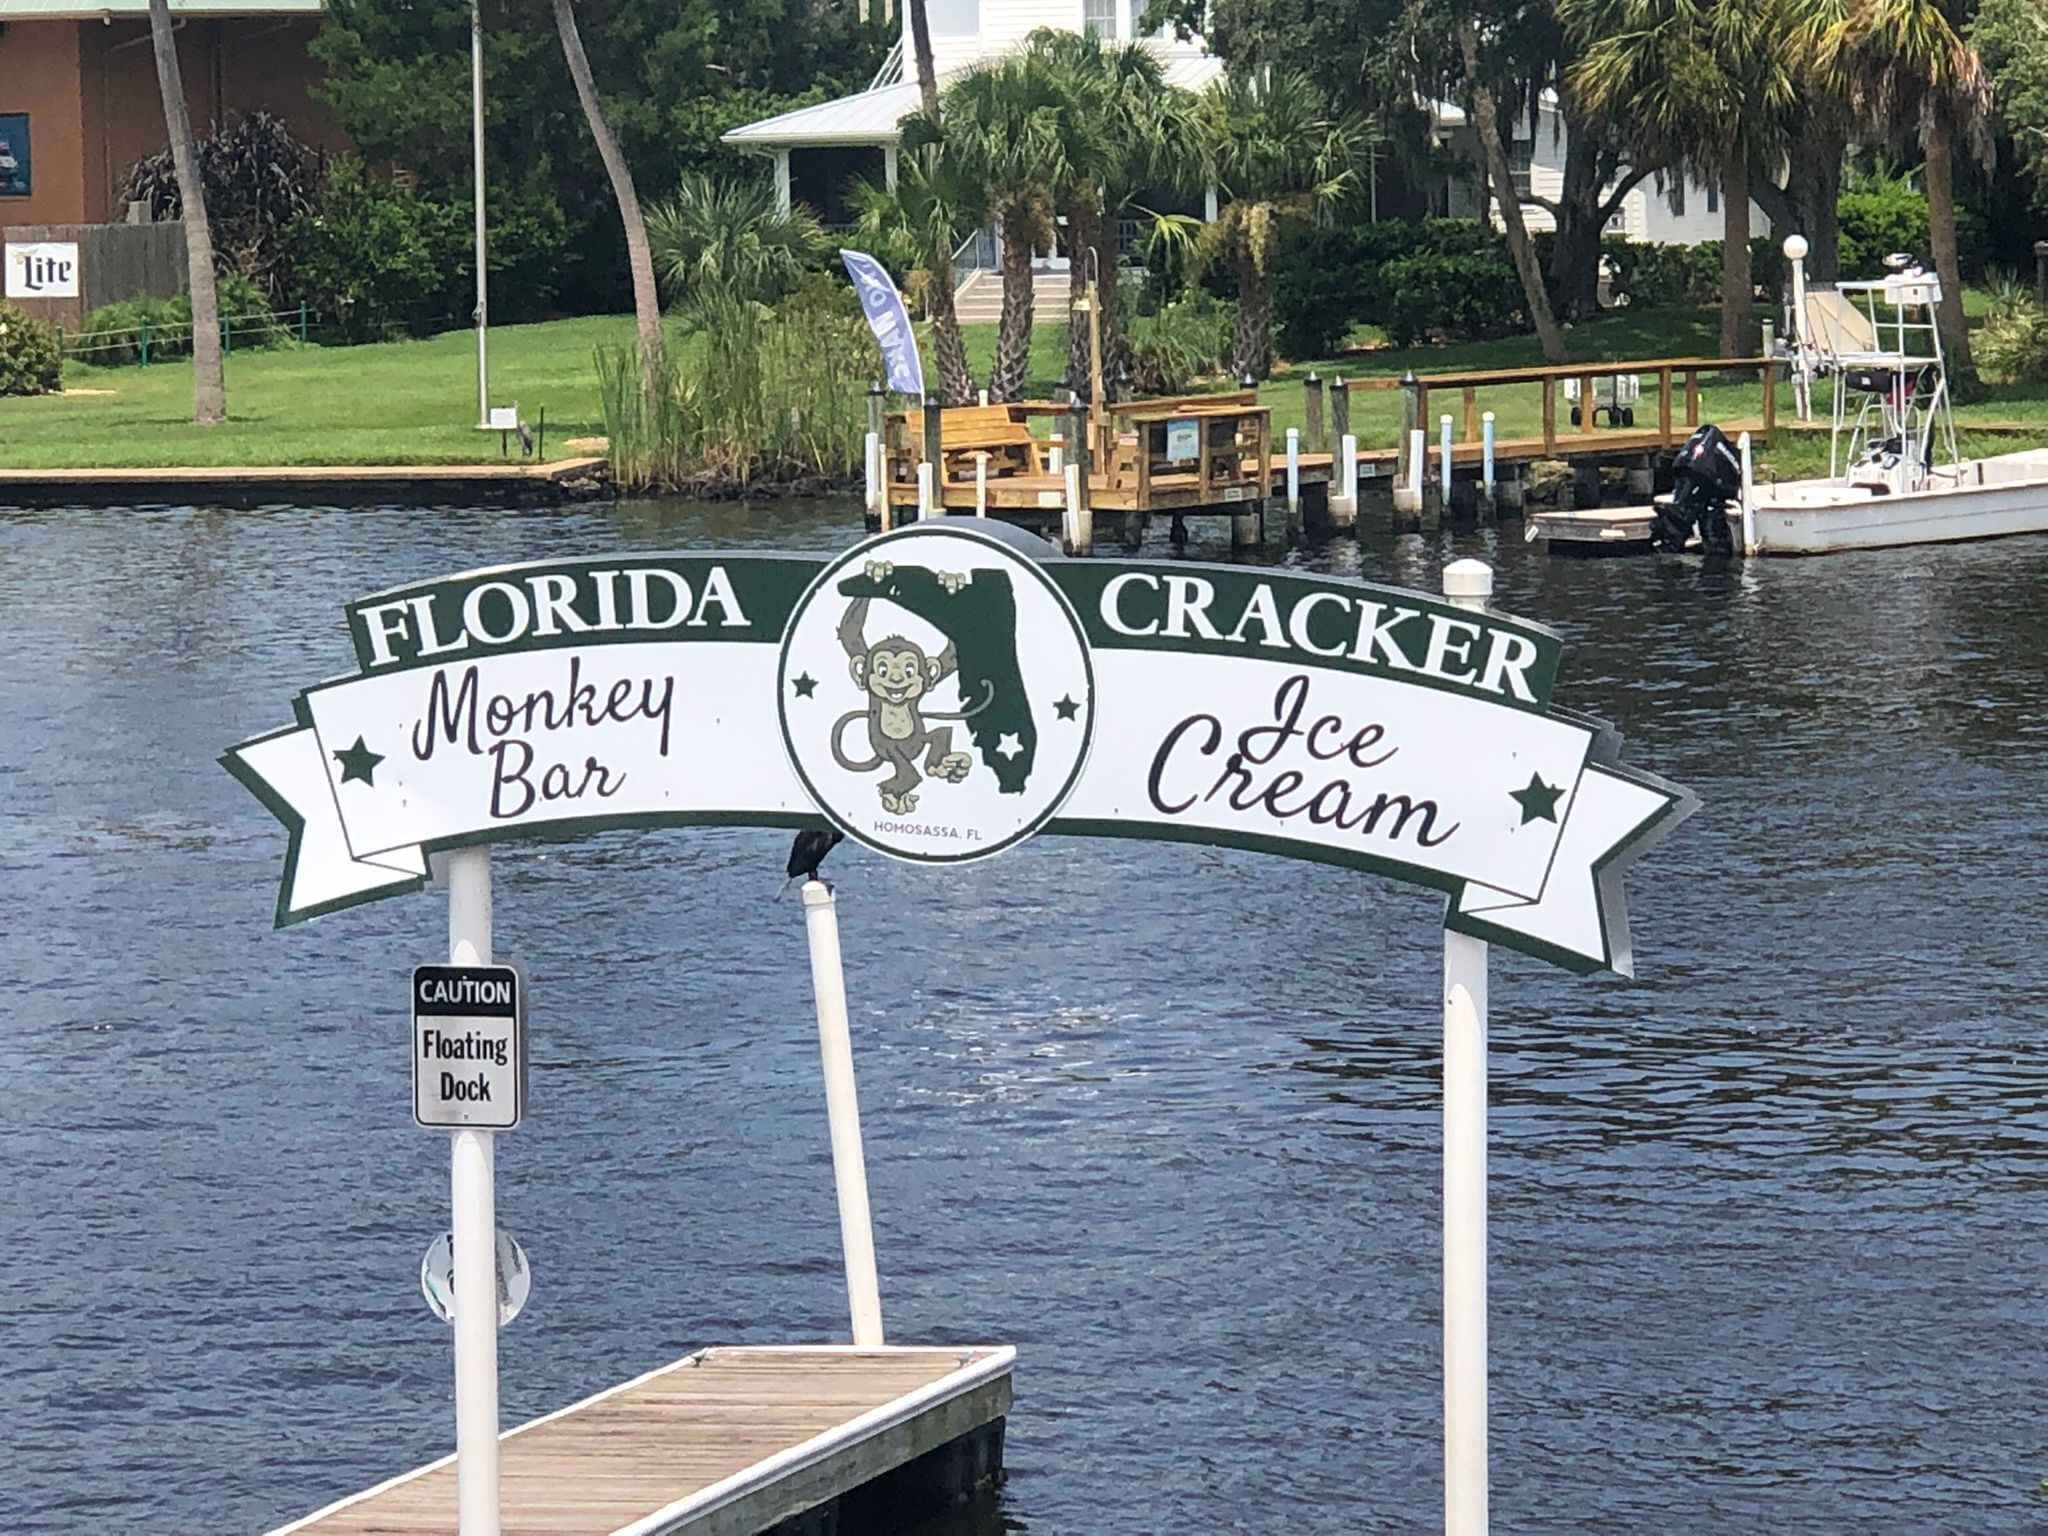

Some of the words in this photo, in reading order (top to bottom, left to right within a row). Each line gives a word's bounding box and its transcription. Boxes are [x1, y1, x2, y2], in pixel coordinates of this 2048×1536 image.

[24, 255, 72, 291] Lite
[357, 566, 752, 667] FLORIDA
[1100, 573, 1538, 704] CRACKER
[412, 656, 674, 761] Monkey
[1238, 675, 1398, 767] Ice
[488, 740, 626, 819] Bar
[1148, 714, 1460, 847] Cream
[966, 828, 982, 841] FL
[420, 979, 511, 1004] CAUTION
[423, 1029, 508, 1066] Floating
[440, 1071, 491, 1101] Dock
